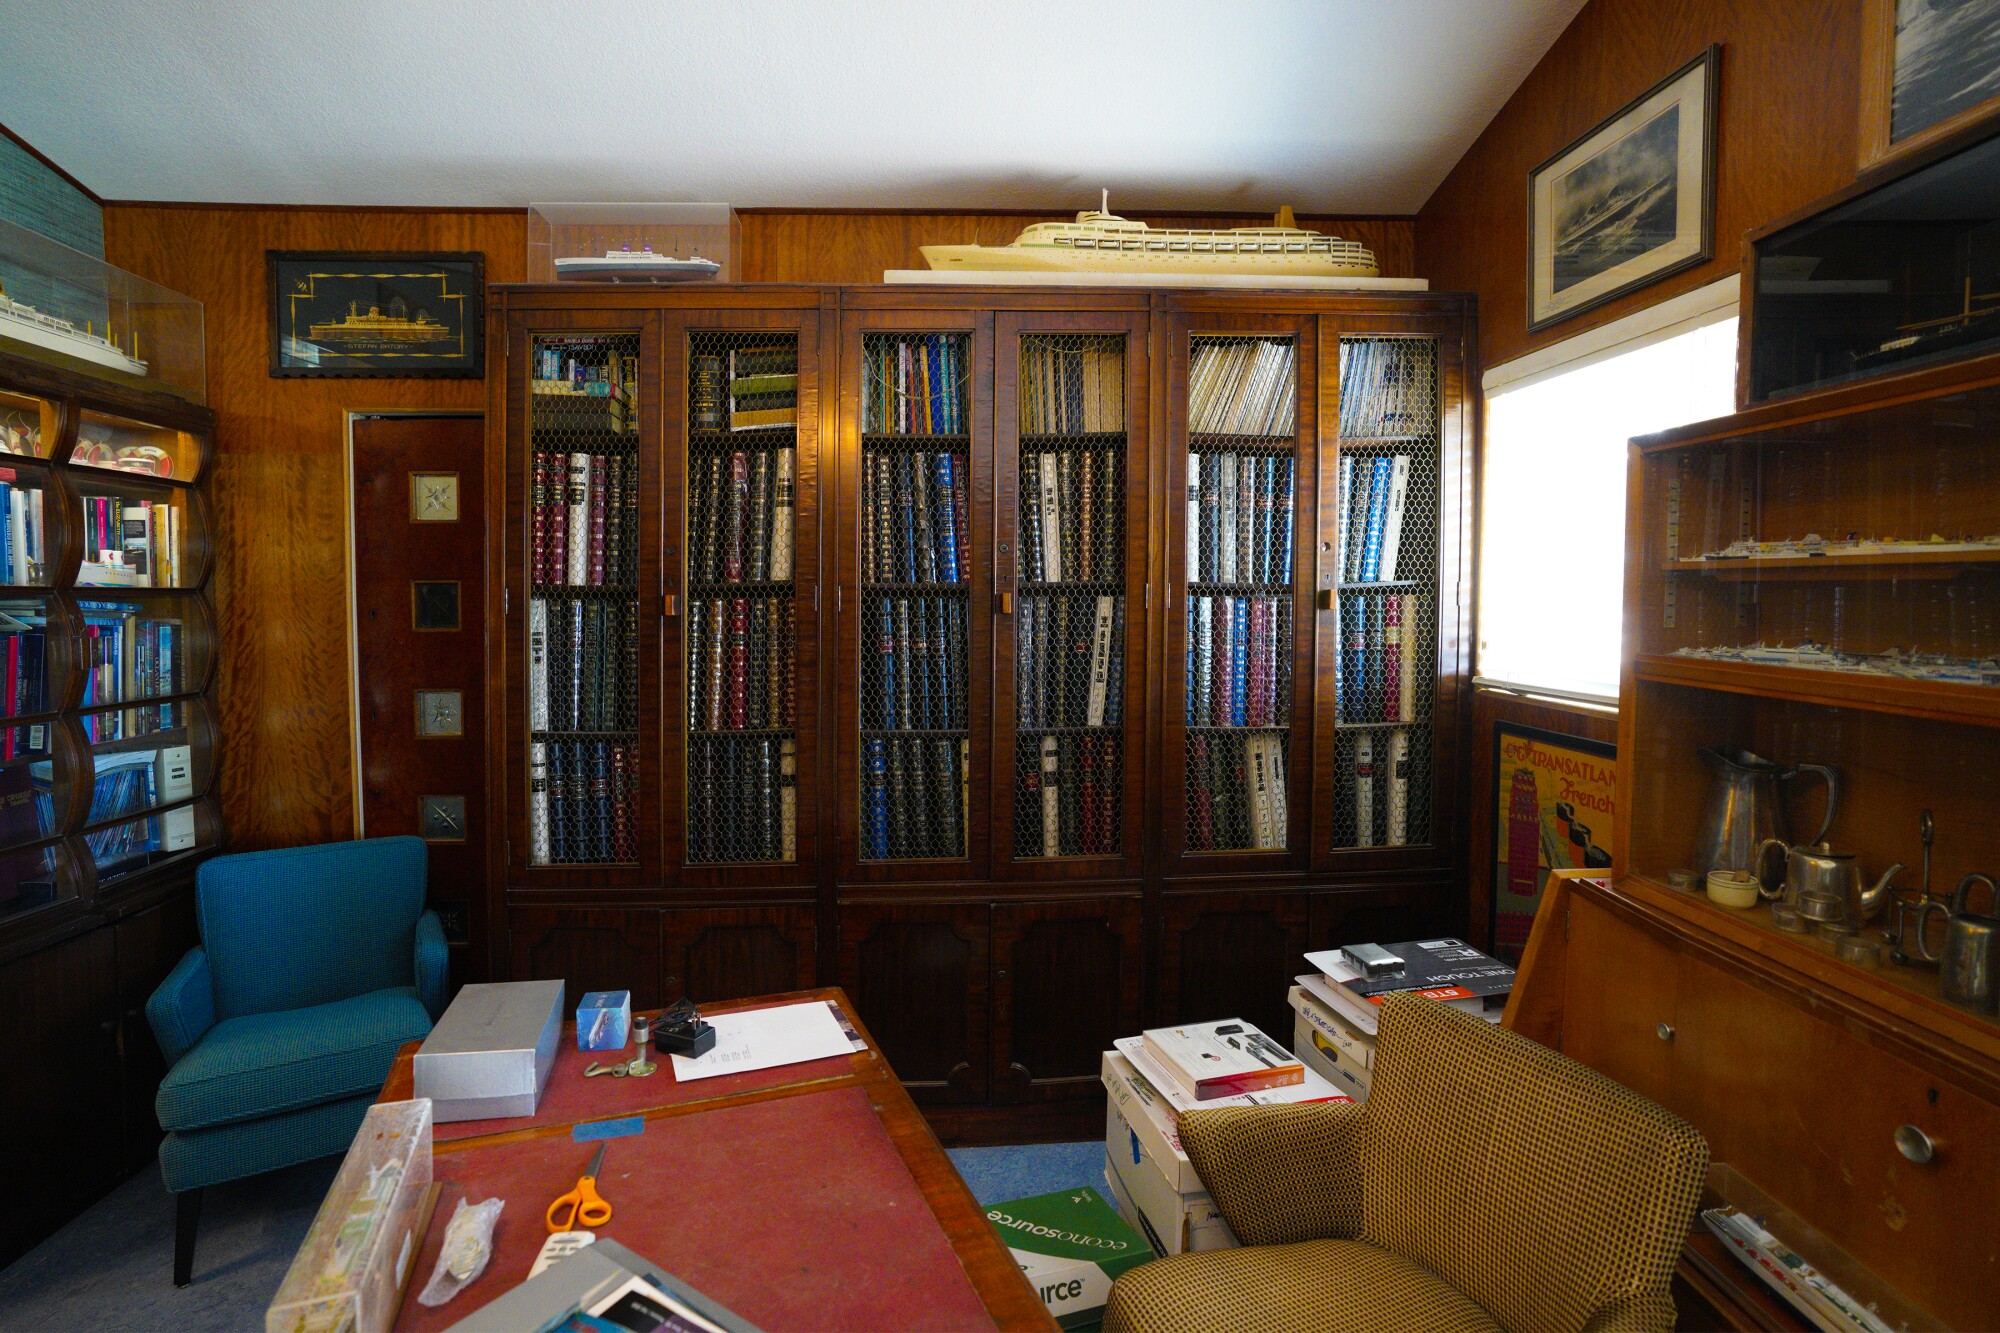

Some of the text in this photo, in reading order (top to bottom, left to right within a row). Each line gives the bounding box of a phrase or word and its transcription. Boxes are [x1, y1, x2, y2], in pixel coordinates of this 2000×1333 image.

[1560, 777, 1617, 815] French
[1426, 969, 1516, 982] ONE TOUCH
[1423, 989, 1459, 999] 5TB
[986, 1210, 1128, 1251] econosource
